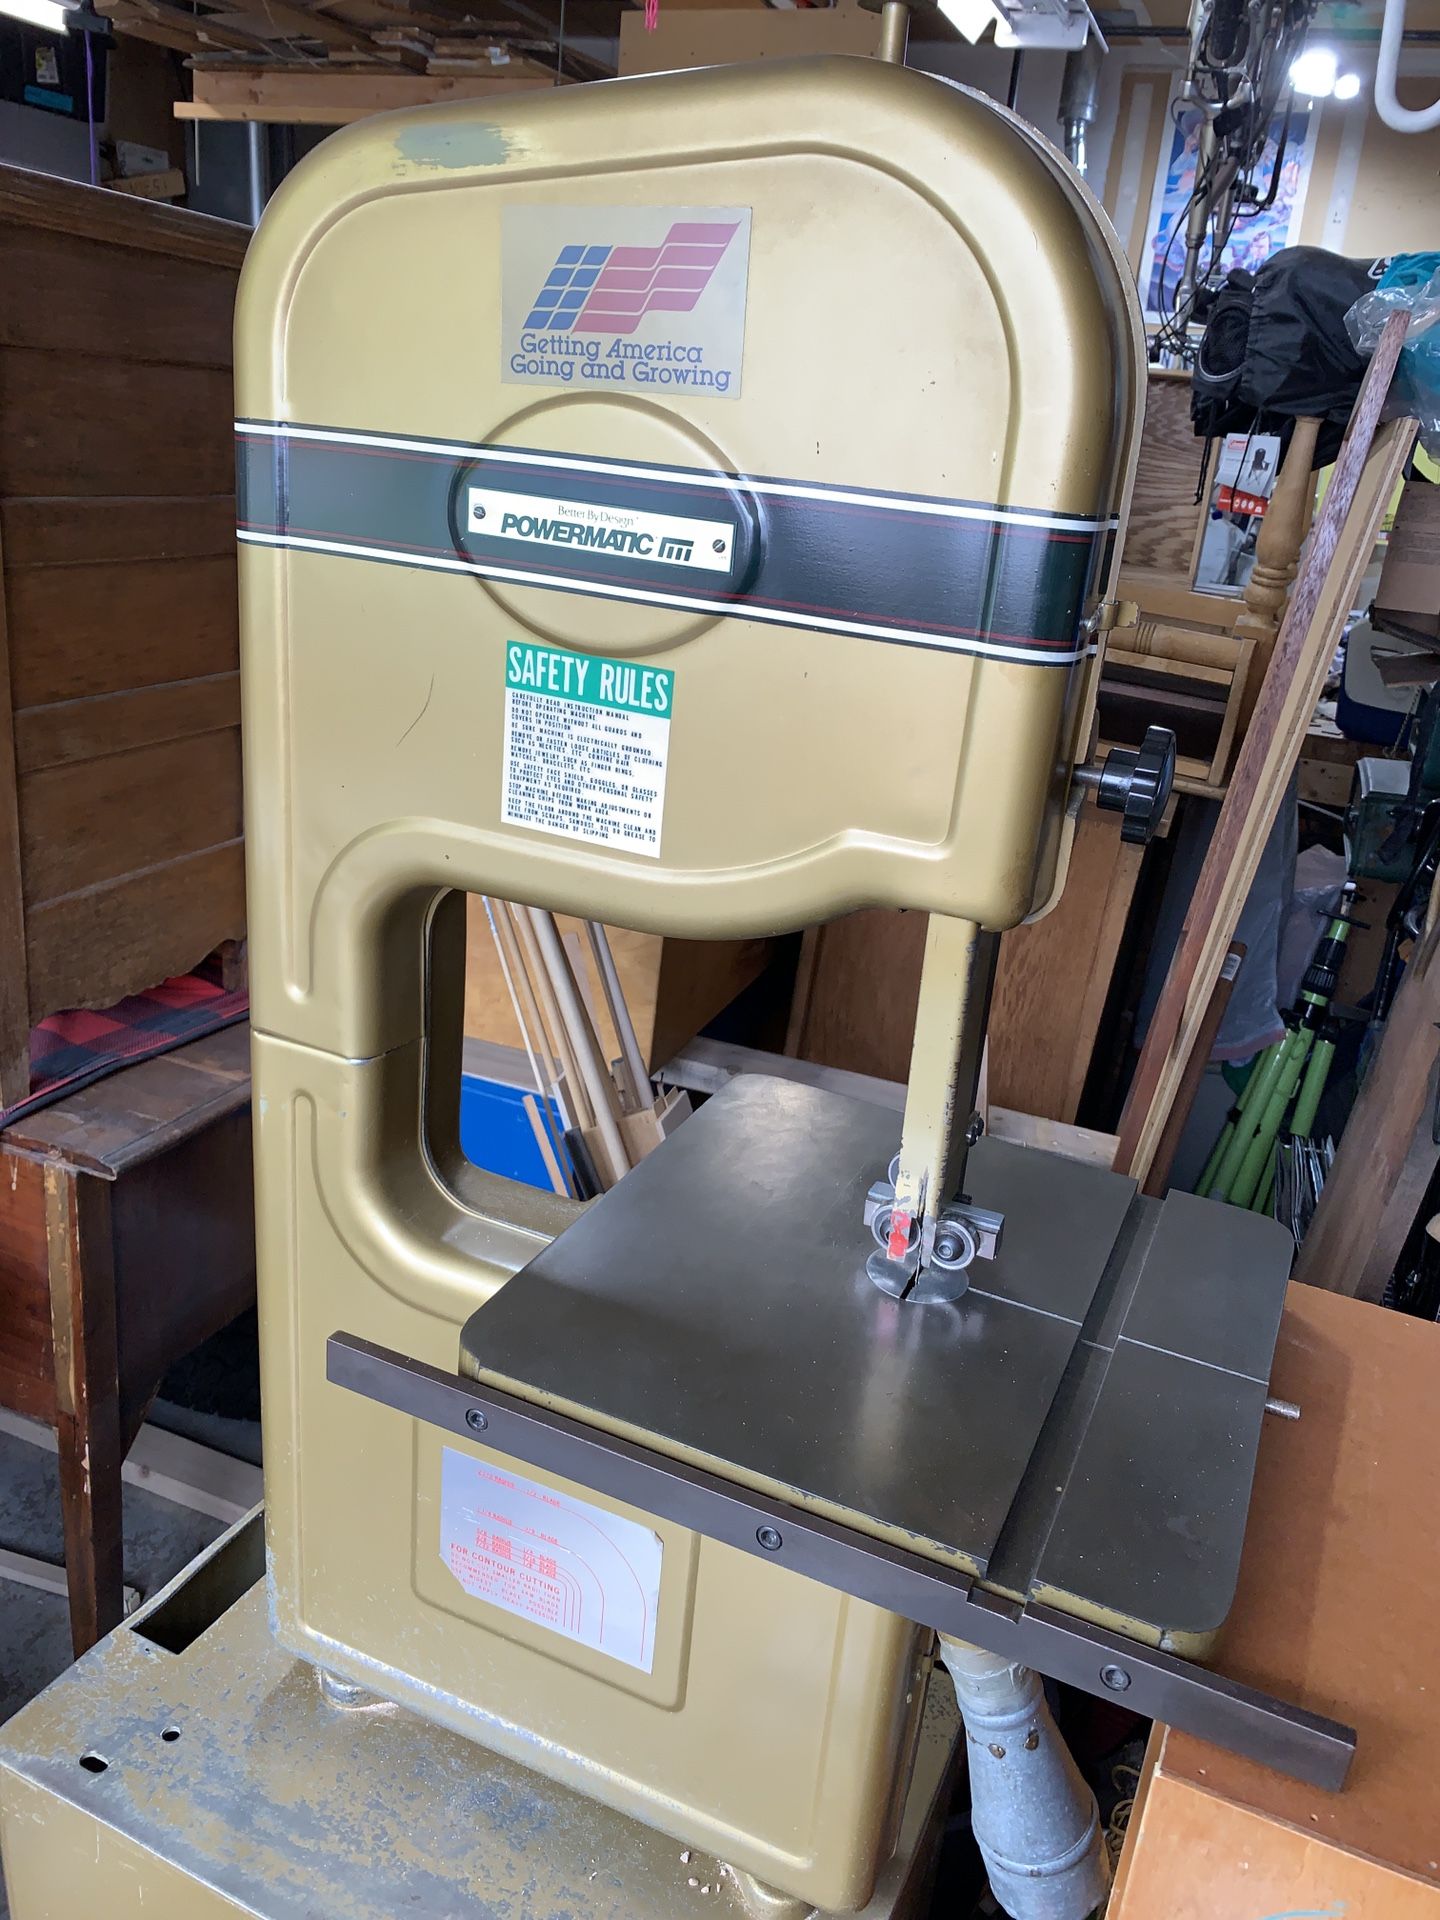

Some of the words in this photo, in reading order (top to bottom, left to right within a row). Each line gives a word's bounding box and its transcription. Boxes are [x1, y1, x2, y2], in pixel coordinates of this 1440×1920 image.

[521, 333, 601, 361] Getting
[606, 339, 703, 362] America
[511, 354, 574, 381] Going
[581, 360, 624, 380] and
[633, 362, 731, 391] Growing
[558, 505, 585, 519] Better
[588, 510, 600, 523] By
[601, 511, 634, 528] Design
[501, 512, 653, 555] POWERMATIC
[508, 646, 590, 696] SAFETY
[600, 664, 668, 711] RULES
[512, 693, 542, 704] CAREFULLY
[546, 699, 560, 707] READ
[564, 703, 602, 715] INSTRUCTION
[512, 699, 531, 708] BEFORE
[536, 704, 566, 715] OPERATING
[512, 714, 532, 723] COVERS
[522, 709, 532, 717] NOT
[535, 712, 559, 722] OPERATE
[564, 718, 588, 728] WITHOUT
[605, 726, 627, 736] GUARDS
[631, 731, 642, 739] AND
[522, 724, 535, 733] SURE
[540, 728, 564, 738] MACHINE
[577, 735, 617, 749] ELECTRICALLY
[511, 731, 532, 741] REMOVE
[547, 738, 567, 748] FASTEN
[571, 743, 589, 752] LOOSE
[593, 747, 620, 759] ARTICLES
[634, 756, 663, 768] CLOTHING
[511, 737, 525, 745] SUCH
[588, 753, 612, 763] CONFINE
[511, 745, 532, 755] REMOVE
[535, 750, 559, 761] JEWELRY
[563, 756, 577, 764] SUCH
[591, 762, 611, 772] FINGER
[510, 774, 541, 786] EQUIPMENT
[519, 769, 543, 779] PROTECT
[547, 775, 560, 783] EYES
[578, 782, 596, 791] OTHER
[599, 786, 627, 798] PERSONAL
[631, 793, 653, 803] SAFETY
[524, 763, 543, 773] SAFETY
[547, 768, 560, 777] FACE
[632, 786, 657, 797] GLASSES
[509, 789, 535, 799] CLEANING
[538, 795, 554, 804] CHIPS
[559, 800, 572, 808] FROM
[577, 804, 591, 812] WORK
[525, 786, 548, 796] MACHINE
[552, 792, 572, 801] BEFORE
[577, 797, 597, 807] MAKING
[601, 803, 641, 816] ADJUSTMENTS
[508, 798, 521, 806] KEEP
[525, 801, 535, 809] THE
[538, 804, 554, 813] FLOOR
[558, 809, 579, 819] AROUND
[596, 817, 620, 828] MACHINE
[624, 823, 641, 832] CLEAN
[645, 828, 656, 836] AND
[508, 811, 531, 822] MINIMIZE
[536, 817, 544, 825] THE
[548, 820, 568, 830] DANGER
[508, 804, 521, 812] FREE
[525, 808, 538, 816] FROM
[624, 830, 645, 840] GREASE
[450, 1543, 468, 1555] FOR
[472, 1552, 515, 1575] CONTOUR
[520, 1573, 560, 1594] CUTTING
